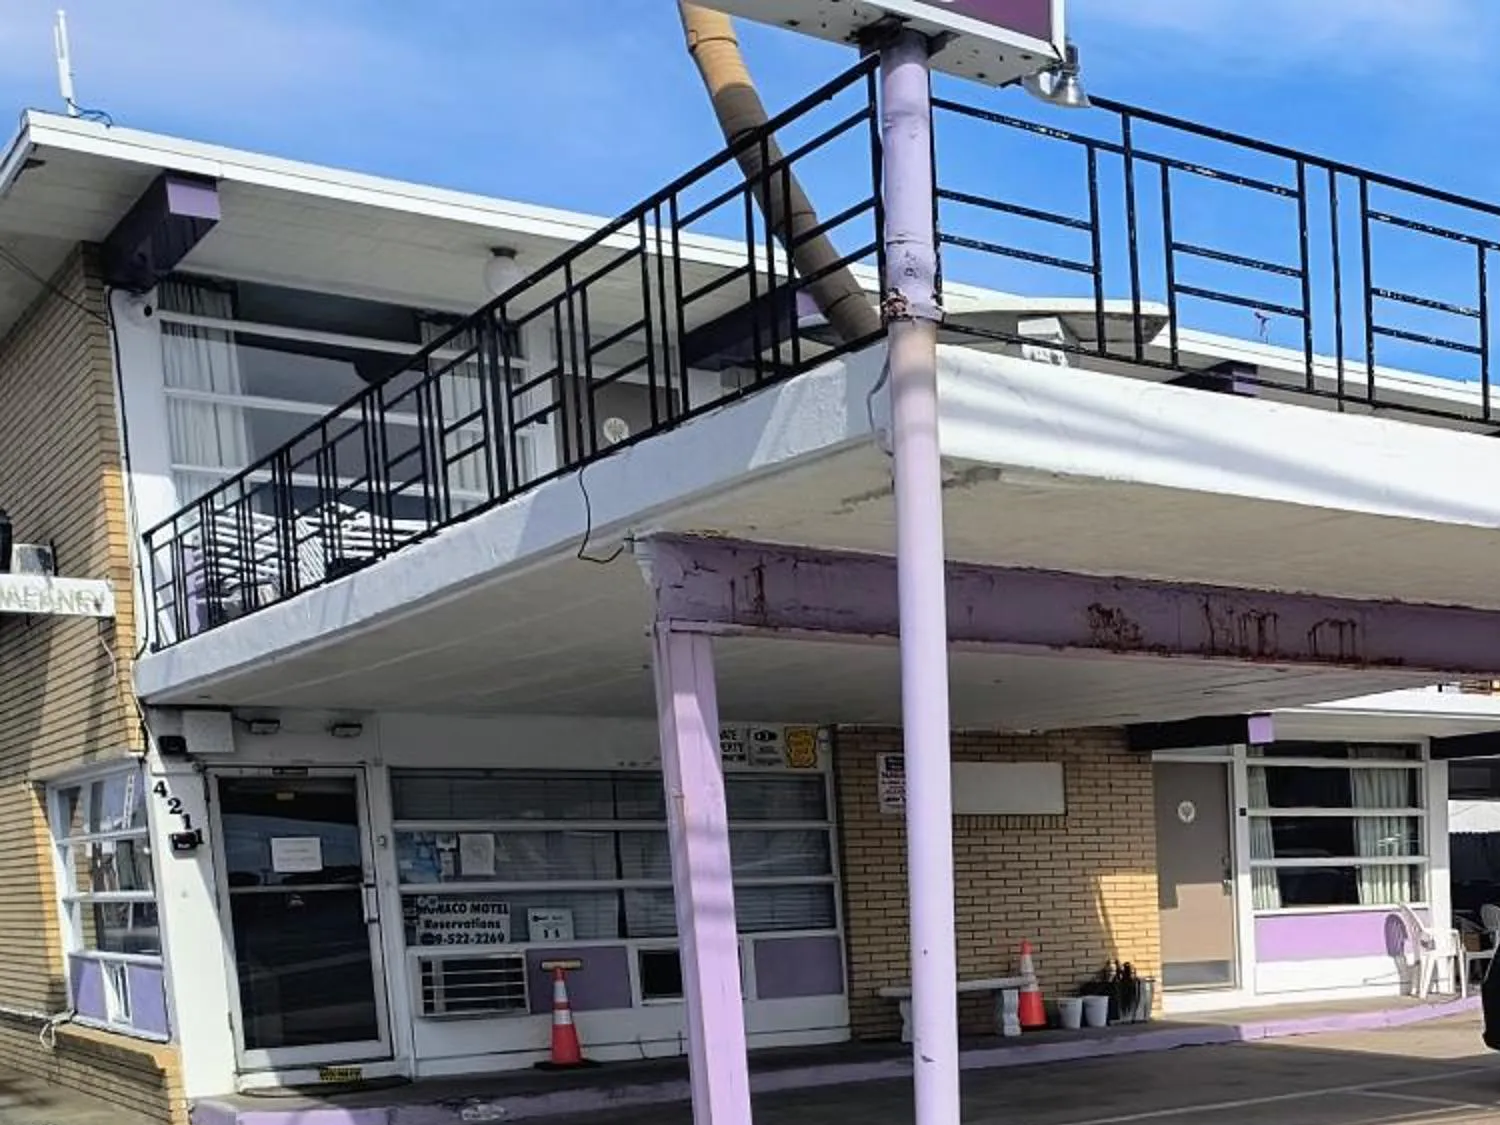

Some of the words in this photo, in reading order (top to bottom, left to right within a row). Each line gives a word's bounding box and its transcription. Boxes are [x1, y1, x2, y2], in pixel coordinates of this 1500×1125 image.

[469, 903, 509, 914] MOTEL
[423, 917, 501, 929] Reservations
[420, 931, 505, 945] 9-522-2269
